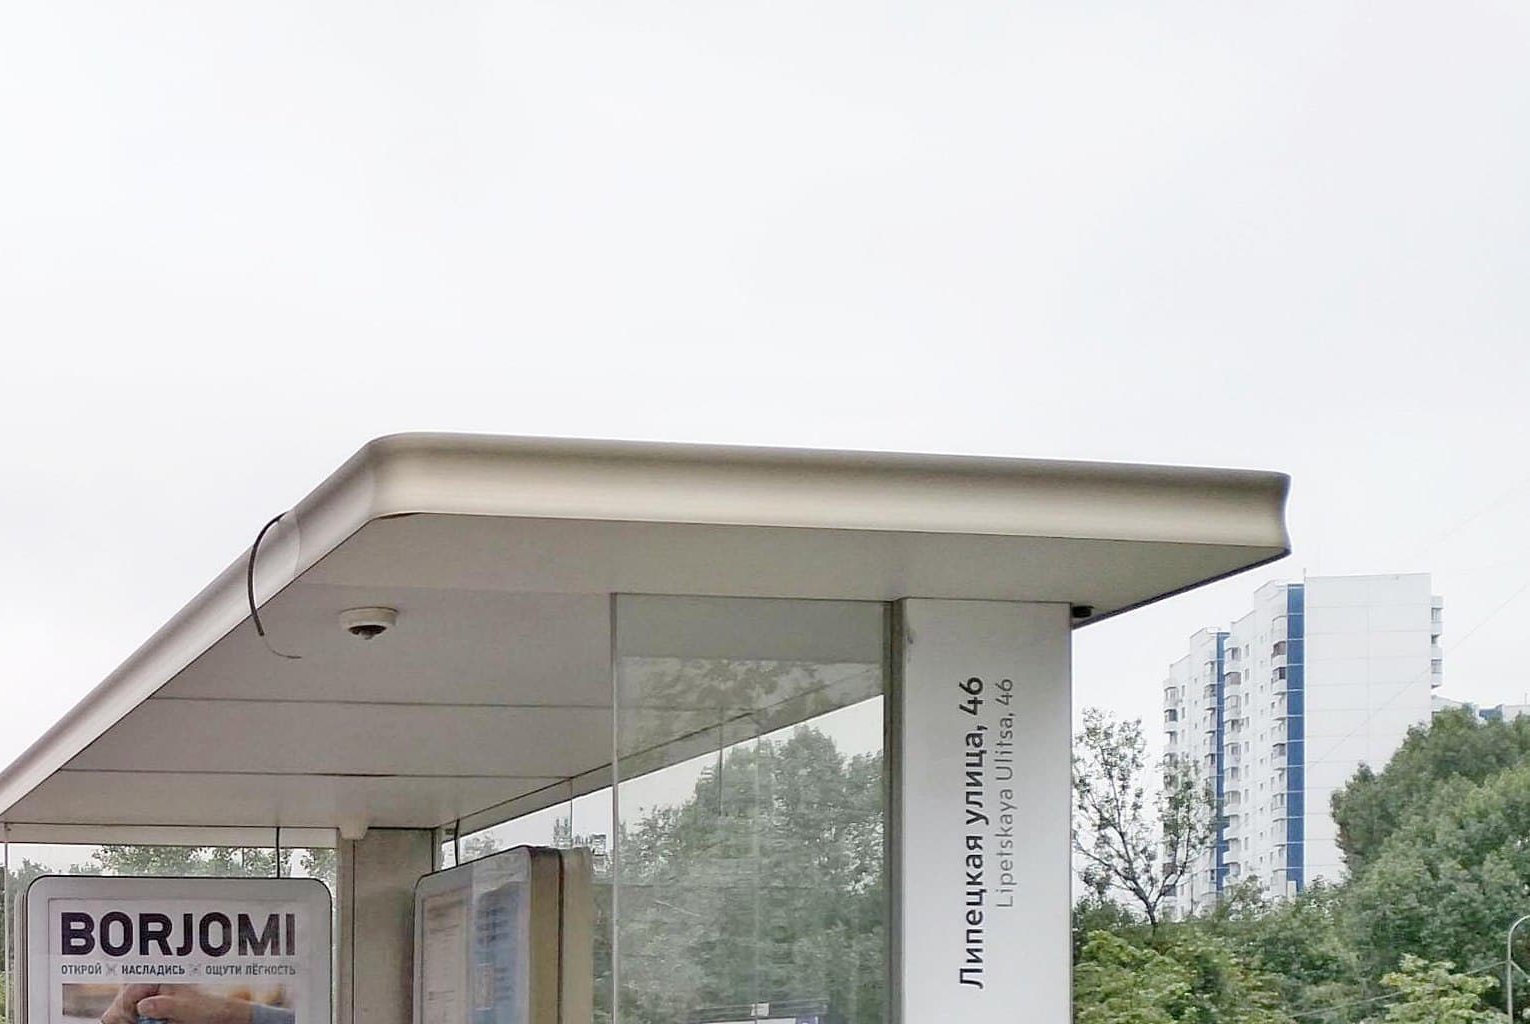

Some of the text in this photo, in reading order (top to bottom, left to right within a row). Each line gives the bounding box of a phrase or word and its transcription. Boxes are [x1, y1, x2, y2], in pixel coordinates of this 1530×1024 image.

[994, 678, 1018, 908] Lipetskaya Ulitsa, 46
[959, 676, 989, 989] Липецкая улица, 46
[61, 911, 296, 957] BORJOMI
[61, 963, 102, 975] ОТКРОЙ
[121, 965, 185, 976] НАСЛАДИСЬ
[206, 963, 296, 976] ОЩУТИ ЛЁГКОСТЬ
